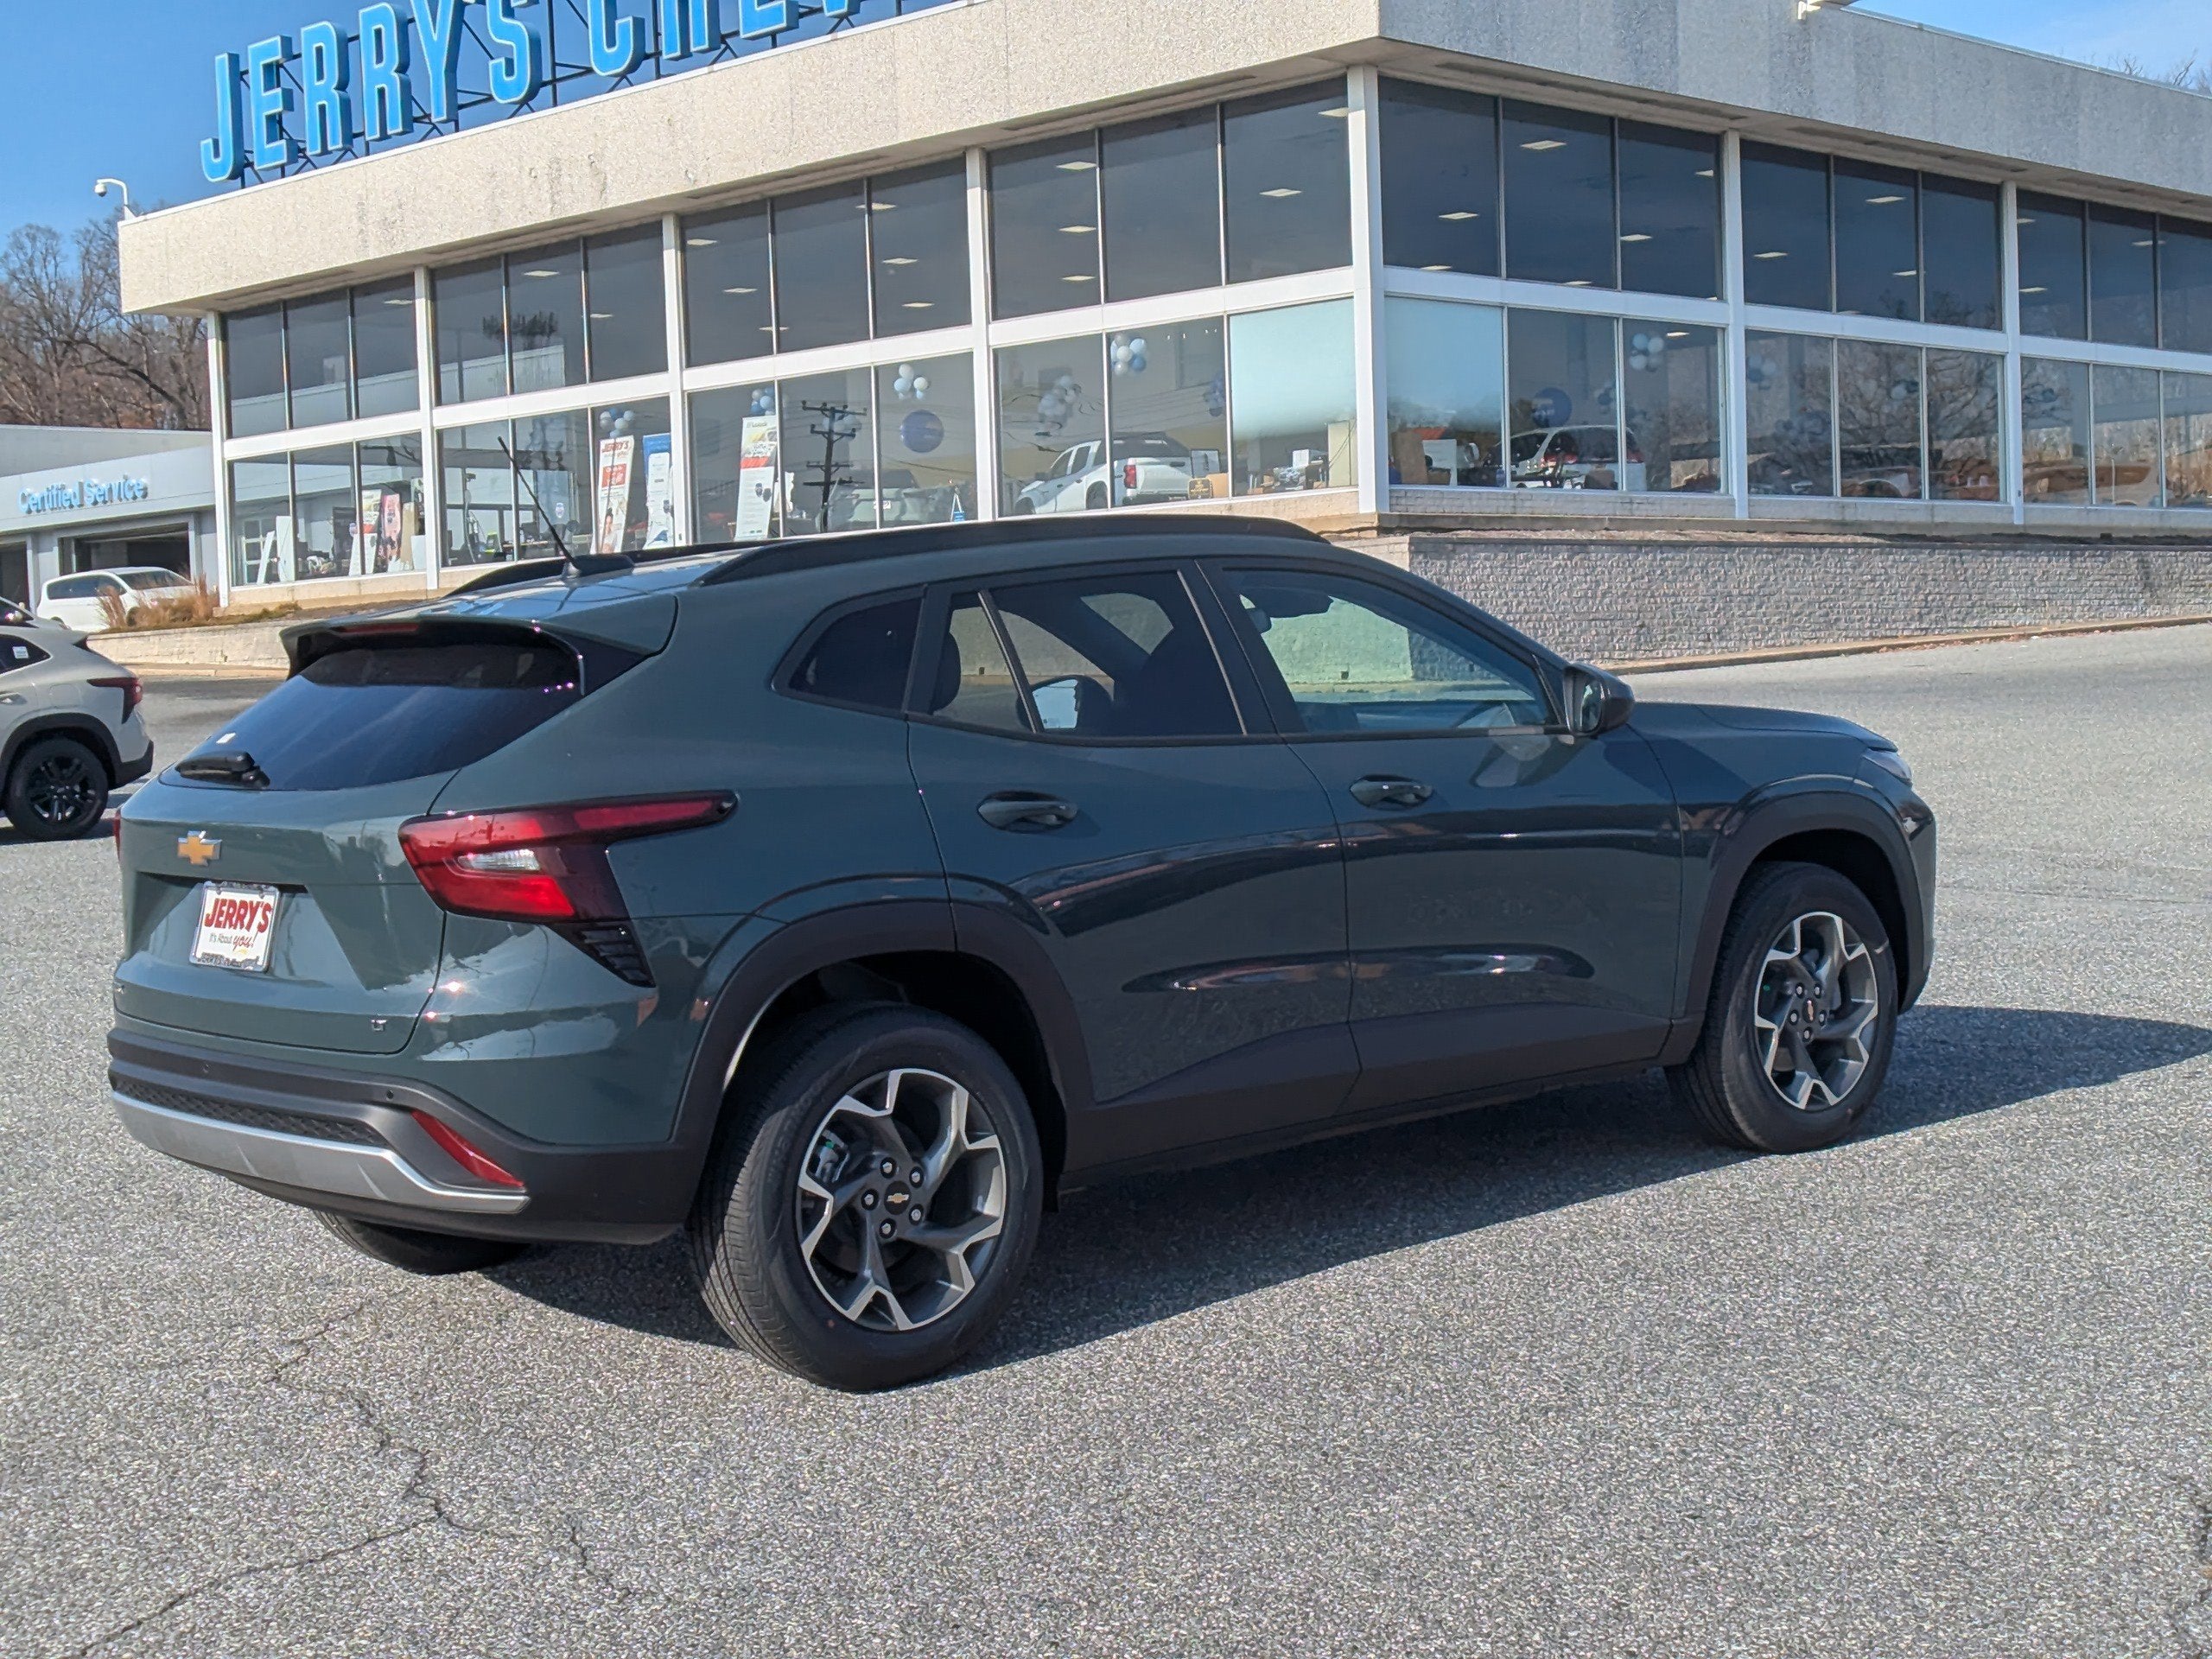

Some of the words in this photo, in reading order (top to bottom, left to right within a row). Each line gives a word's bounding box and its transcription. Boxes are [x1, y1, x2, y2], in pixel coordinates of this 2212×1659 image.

[200, 0, 543, 182] JERRYS
[17, 480, 83, 514] Certified
[84, 474, 148, 507] Service
[204, 898, 272, 933] JERRY'S
[232, 931, 258, 951] you!
